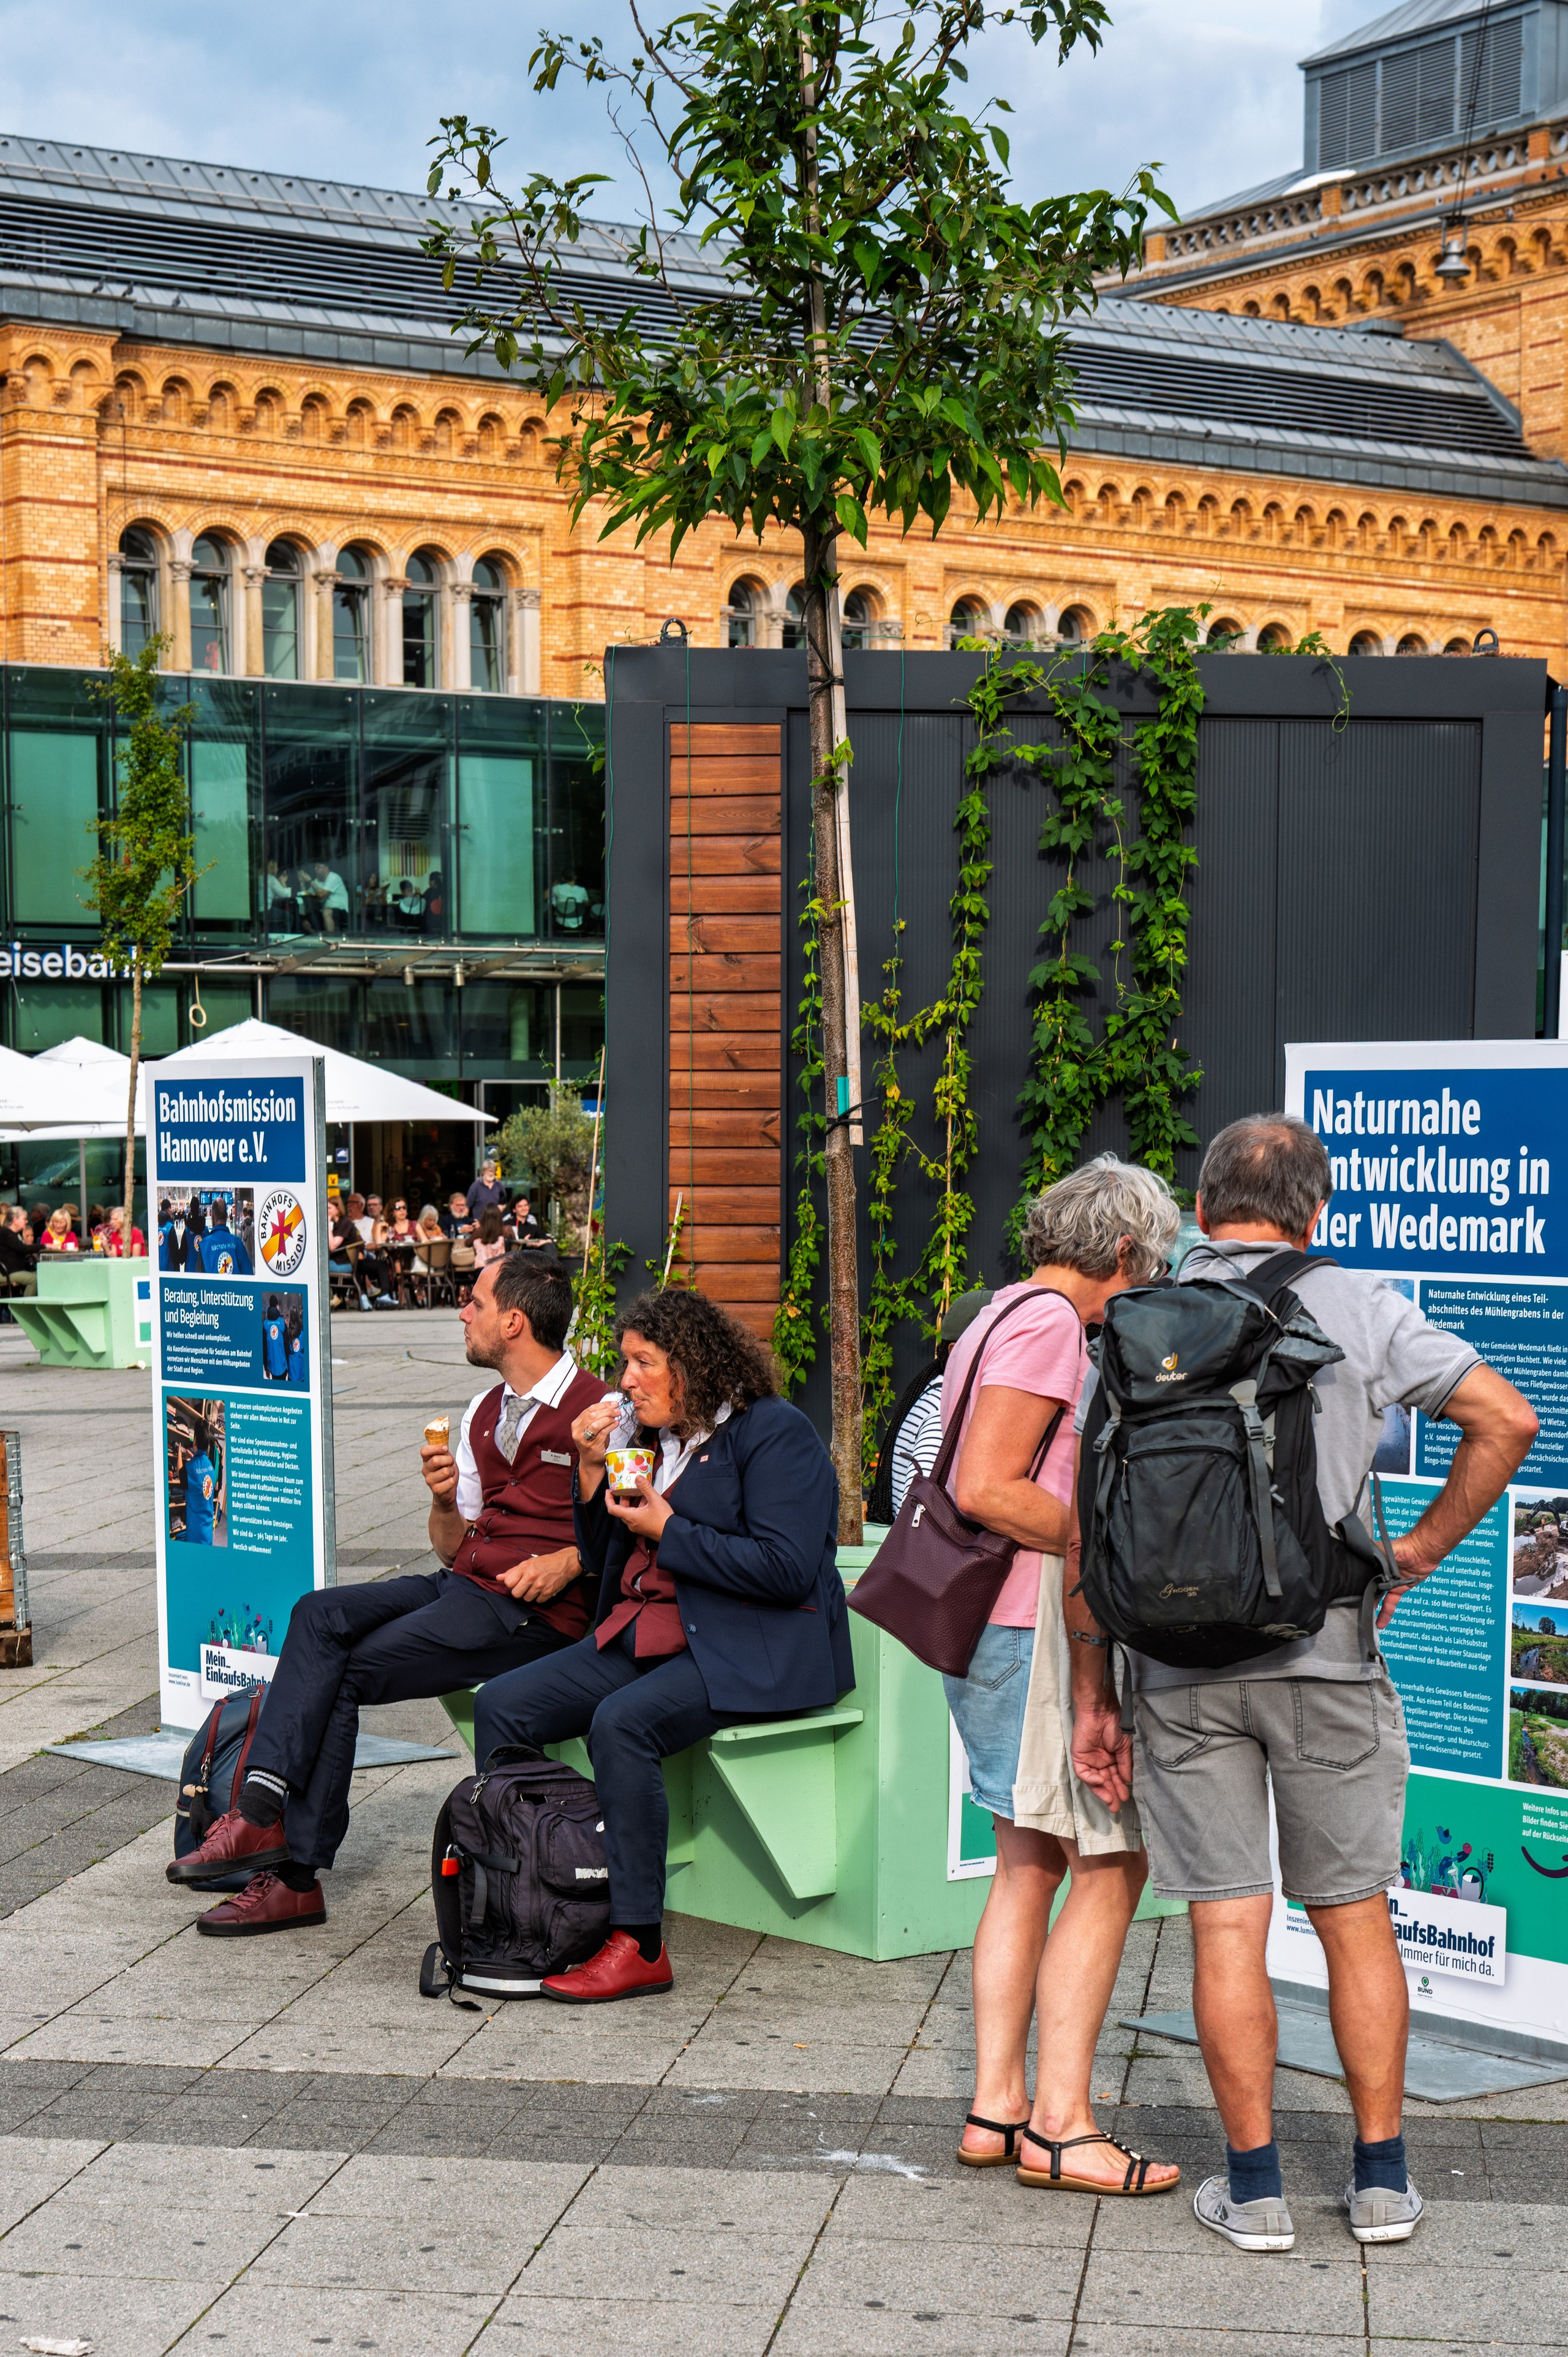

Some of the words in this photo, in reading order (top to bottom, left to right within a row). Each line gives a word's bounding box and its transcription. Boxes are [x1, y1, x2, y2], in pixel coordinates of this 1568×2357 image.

[159, 1089, 296, 1122] Bahnhofsmission
[1313, 1088, 1480, 1135] Naturnahe
[160, 1132, 235, 1162] Hannover
[239, 1132, 268, 1162] e.V.
[1325, 1144, 1510, 1206] ntwicklung
[1519, 1145, 1550, 1194] in
[260, 1195, 293, 1239] BAHNHOFS
[1370, 1203, 1546, 1254] Wedemark
[276, 1233, 304, 1271] MISSION
[164, 1287, 199, 1307] Beratung,
[200, 1289, 254, 1311] Unterstützung
[1428, 1289, 1465, 1300] Naturnahe
[1467, 1290, 1510, 1304] Entwicklung
[1511, 1293, 1531, 1303] eines
[1532, 1293, 1548, 1303] Teil-
[1428, 1304, 1469, 1315] abschnittes
[1470, 1306, 1483, 1315] des
[1485, 1307, 1541, 1319] Mühlengrabens
[1543, 1309, 1550, 1318] in
[1551, 1309, 1564, 1320] der
[165, 1309, 179, 1323] und
[180, 1309, 219, 1329] Begleitung
[1427, 1319, 1464, 1330] Wedemark
[173, 1345, 209, 1355] Koordinierungsstelle
[1490, 1342, 1518, 1350] Gemeinde
[1518, 1343, 1547, 1352] Wedemark
[1547, 1344, 1562, 1353] fließt
[222, 1360, 251, 1368] Hilfsangeboten
[1483, 1353, 1515, 1363] begradigten
[1517, 1355, 1542, 1364] Bachbett.
[1553, 1357, 1567, 1366] viele
[190, 1366, 205, 1375] Region.
[1155, 1371, 1188, 1382] deuter
[1513, 1368, 1552, 1377] Mühlengraben
[1514, 1379, 1529, 1389] eines
[252, 1404, 282, 1413] unkomplizierten
[282, 1407, 303, 1415] Angeboten
[1547, 1418, 1567, 1428] Wietze,
[1425, 1445, 1453, 1455] Beteiligung
[1534, 1441, 1564, 1451] finanzieller
[1525, 1453, 1568, 1463] edersächsischen
[1517, 1465, 1543, 1474] gestartet.
[273, 1520, 294, 1530] Umsteigen.
[248, 1545, 272, 1554] willkommen!
[1450, 1578, 1477, 1587] eingebaut.
[1479, 1581, 1494, 1590] Insge-
[1421, 1610, 1448, 1619] Gewässers
[1460, 1614, 1486, 1625] Sicherung
[1404, 1655, 1426, 1663] während
[1436, 1658, 1468, 1668] Bauarbeiten
[1400, 1682, 1425, 1692] innerhalb
[1435, 1687, 1463, 1697] Gewässers
[1463, 1691, 1493, 1701] Retentions-
[1406, 1706, 1428, 1716] Reptilien
[1428, 1711, 1452, 1720] angelegt.
[1453, 1712, 1468, 1722] Diese
[1468, 1716, 1488, 1724] können
[1406, 1718, 1443, 1729] Winterquartier
[1464, 1726, 1474, 1735] Des
[1425, 1744, 1462, 1756] Gewässernähe
[1523, 1803, 1545, 1813] Weitere
[1545, 1806, 1559, 1816] Infos
[1522, 1815, 1540, 1825] Bilder
[1540, 1818, 1558, 1828] finden
[1393, 1921, 1495, 1958] aufsBahnhof
[1400, 1944, 1433, 1963] Immer
[1435, 1951, 1450, 1967] für
[1452, 1957, 1477, 1972] mich
[1479, 1961, 1494, 1977] da.
